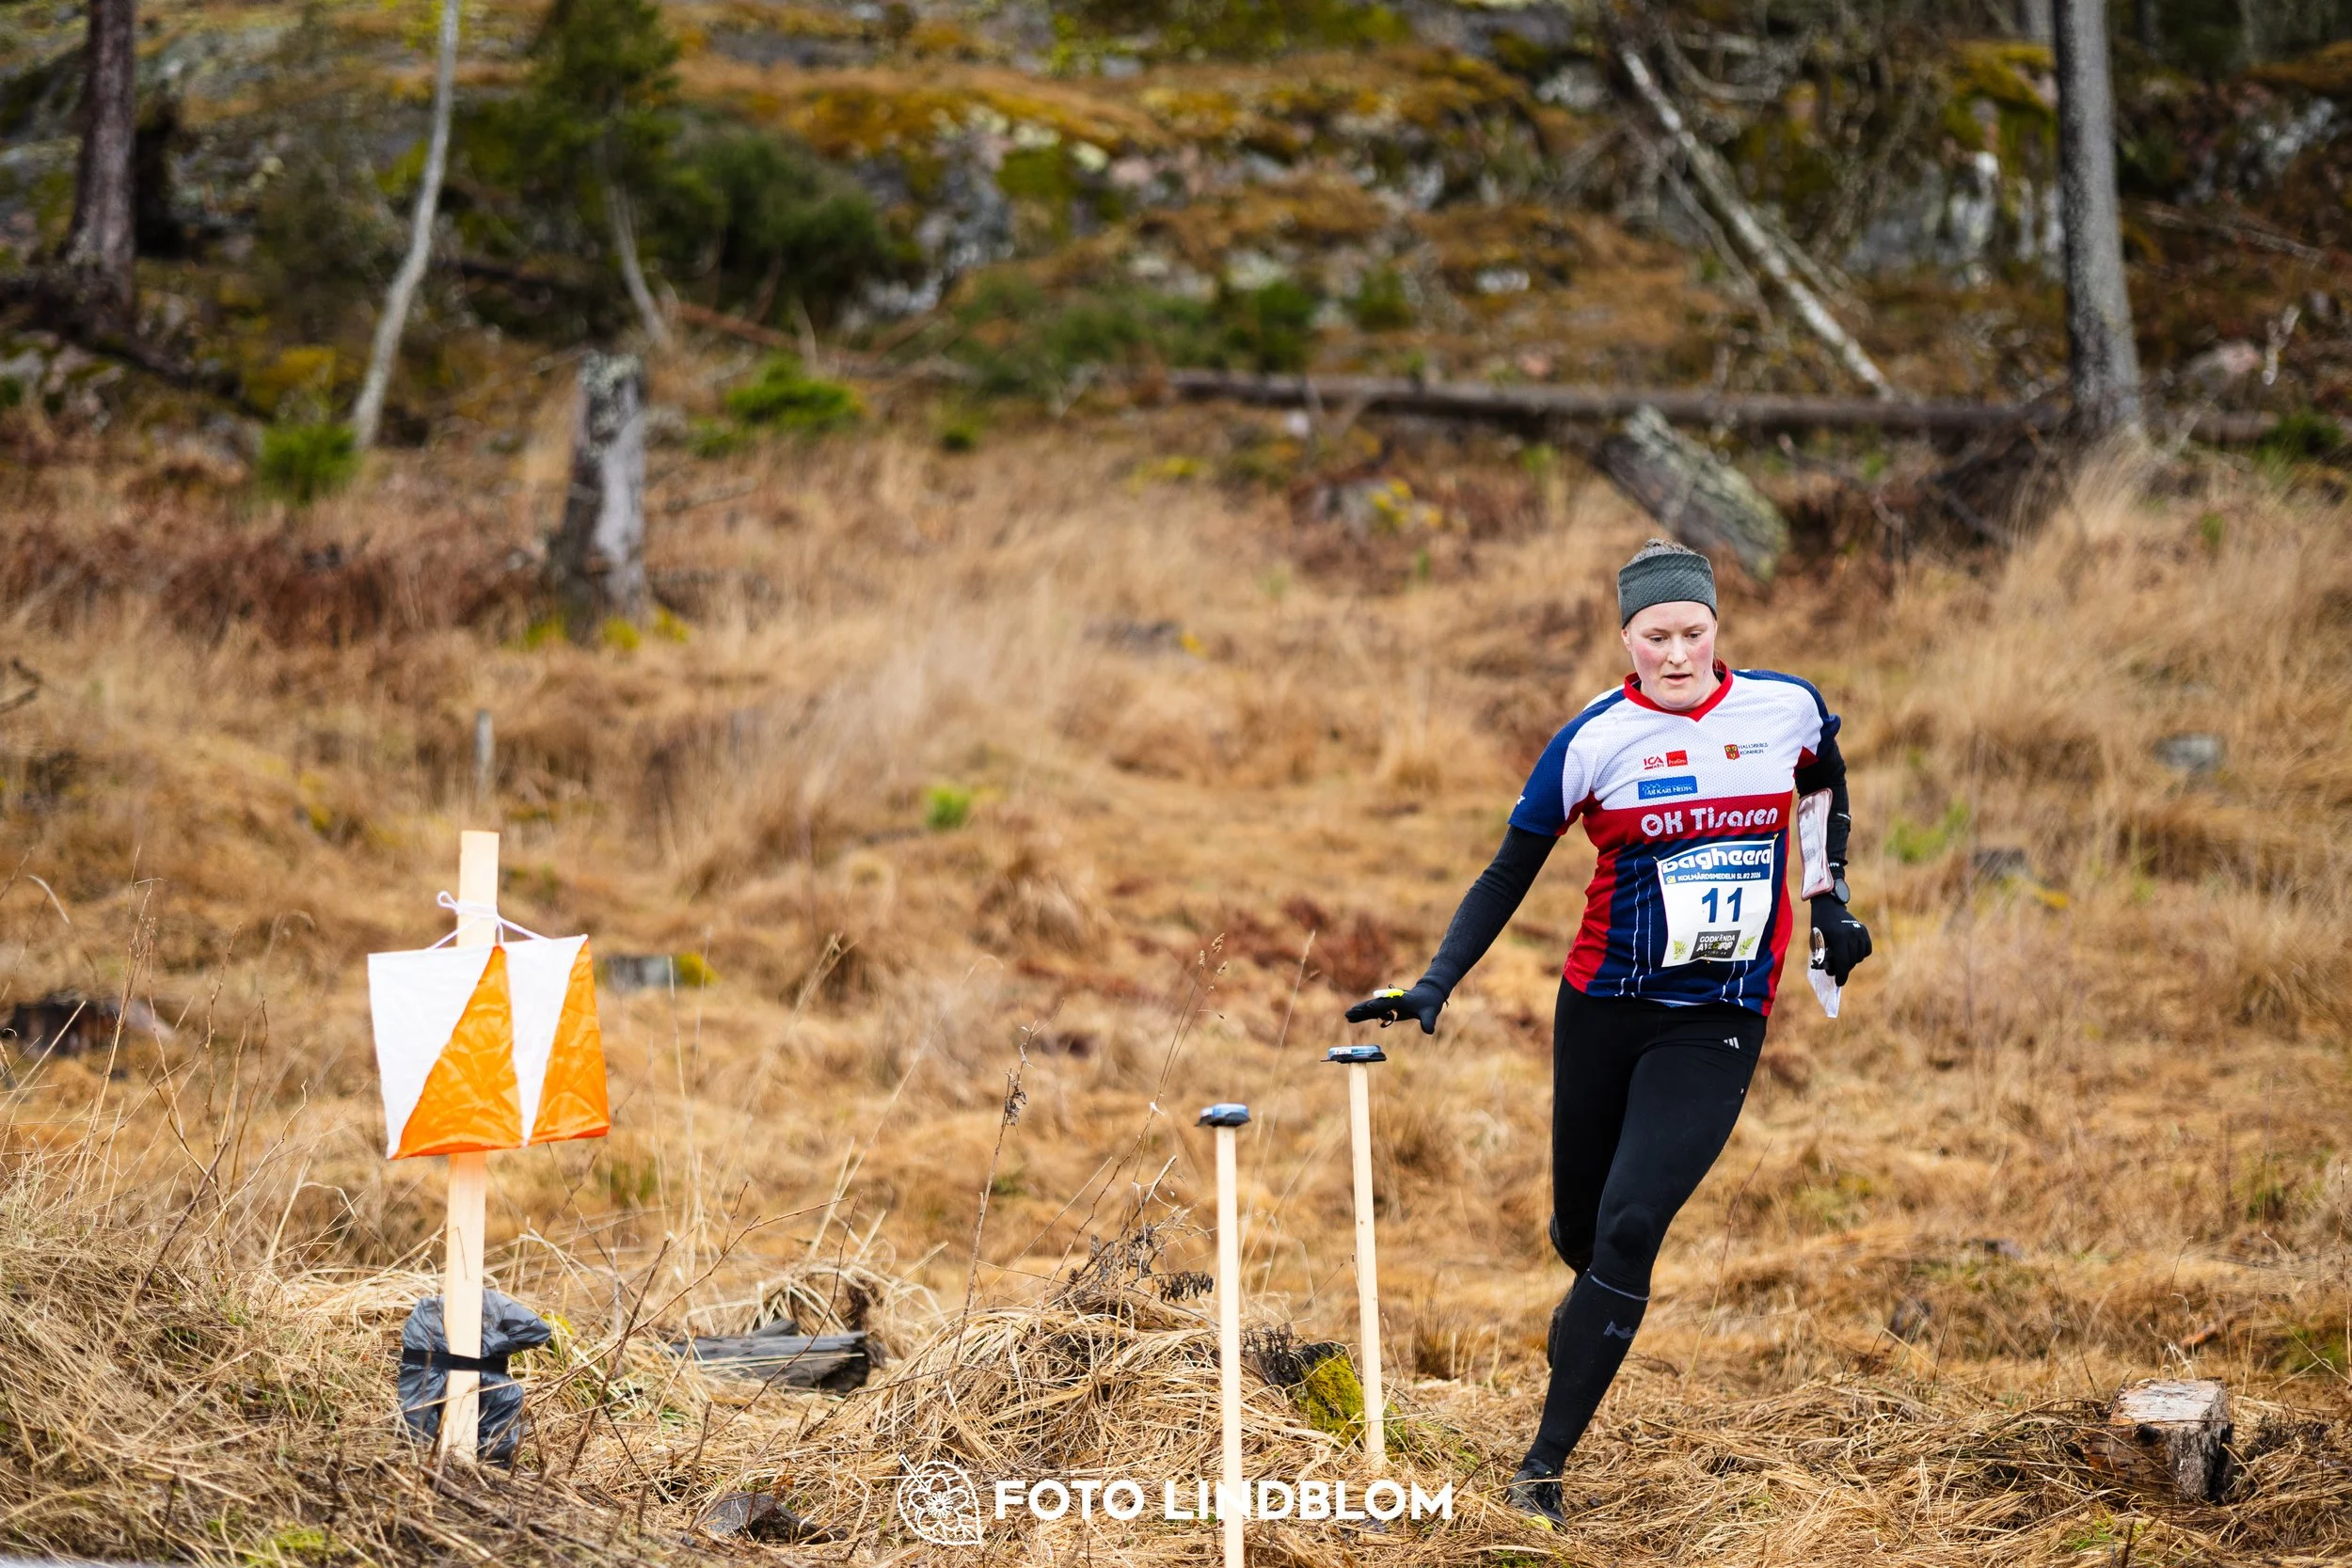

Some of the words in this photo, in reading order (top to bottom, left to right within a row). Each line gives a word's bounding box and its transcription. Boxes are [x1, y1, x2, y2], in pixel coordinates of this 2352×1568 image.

[1643, 756, 1664, 767] ICA
[1641, 810, 1684, 836] OK
[1690, 806, 1778, 831] Tisaren
[1701, 887, 1743, 924] 11
[1699, 934, 1736, 942] GODKÄNDA
